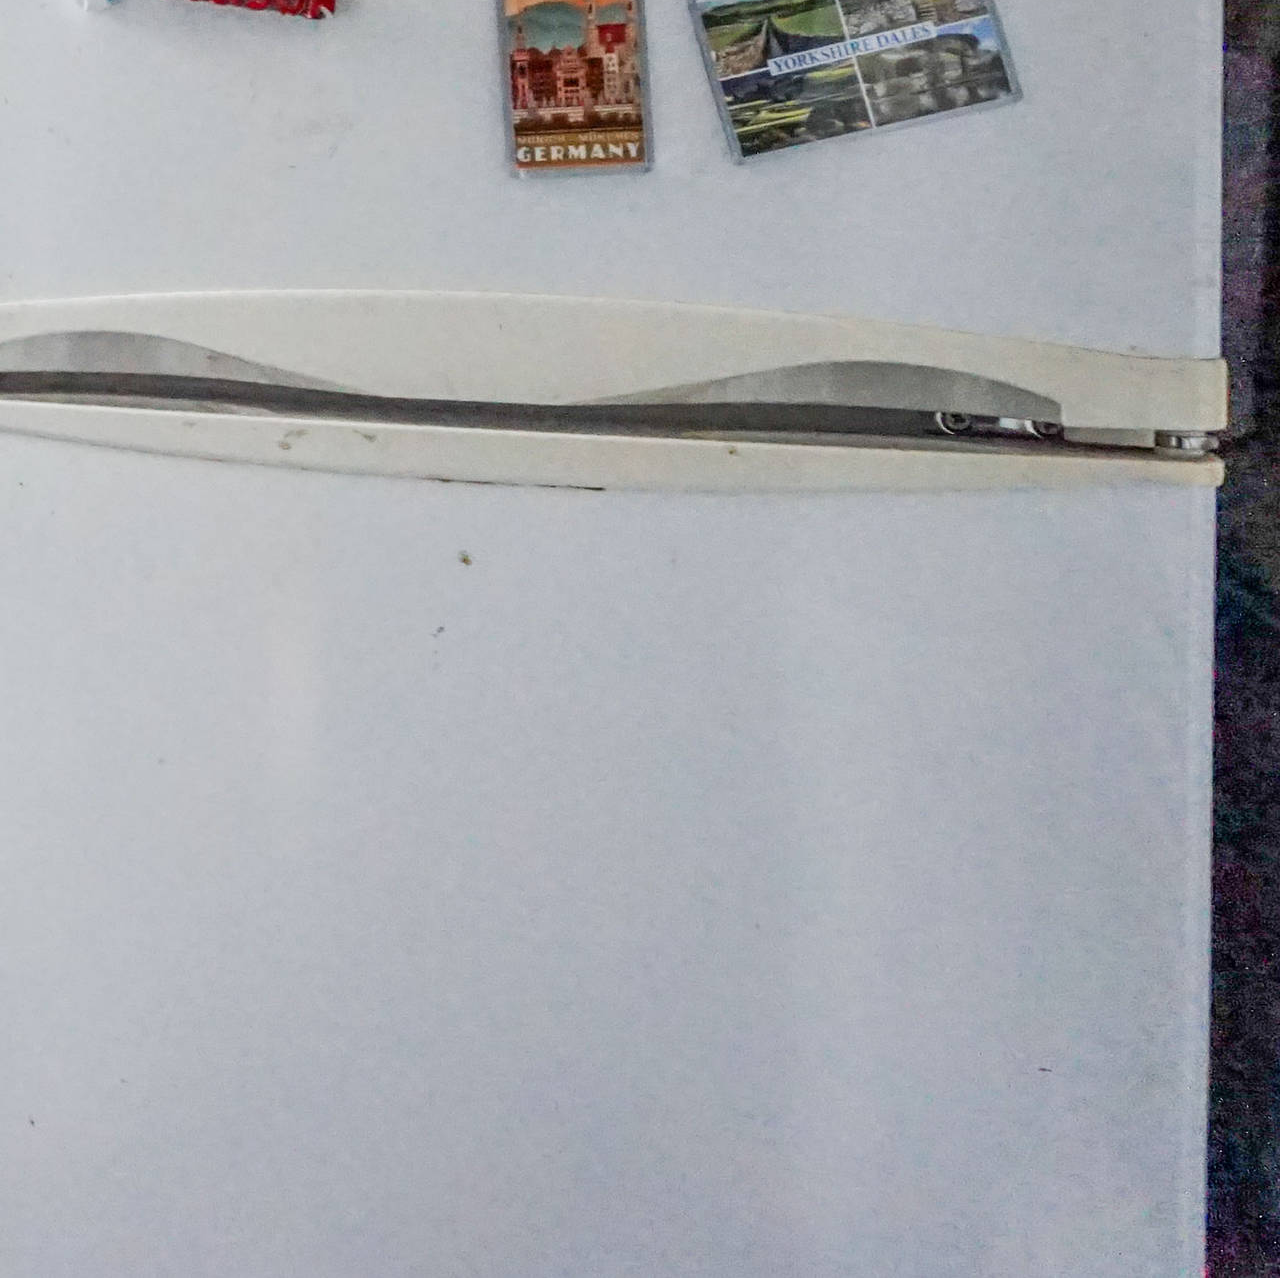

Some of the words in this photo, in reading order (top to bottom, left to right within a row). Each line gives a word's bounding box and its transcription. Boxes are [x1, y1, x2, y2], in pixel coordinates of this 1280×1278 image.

[772, 39, 875, 73] YORKSHIRE
[876, 24, 932, 49] DALES
[516, 141, 640, 163] GERMANY
